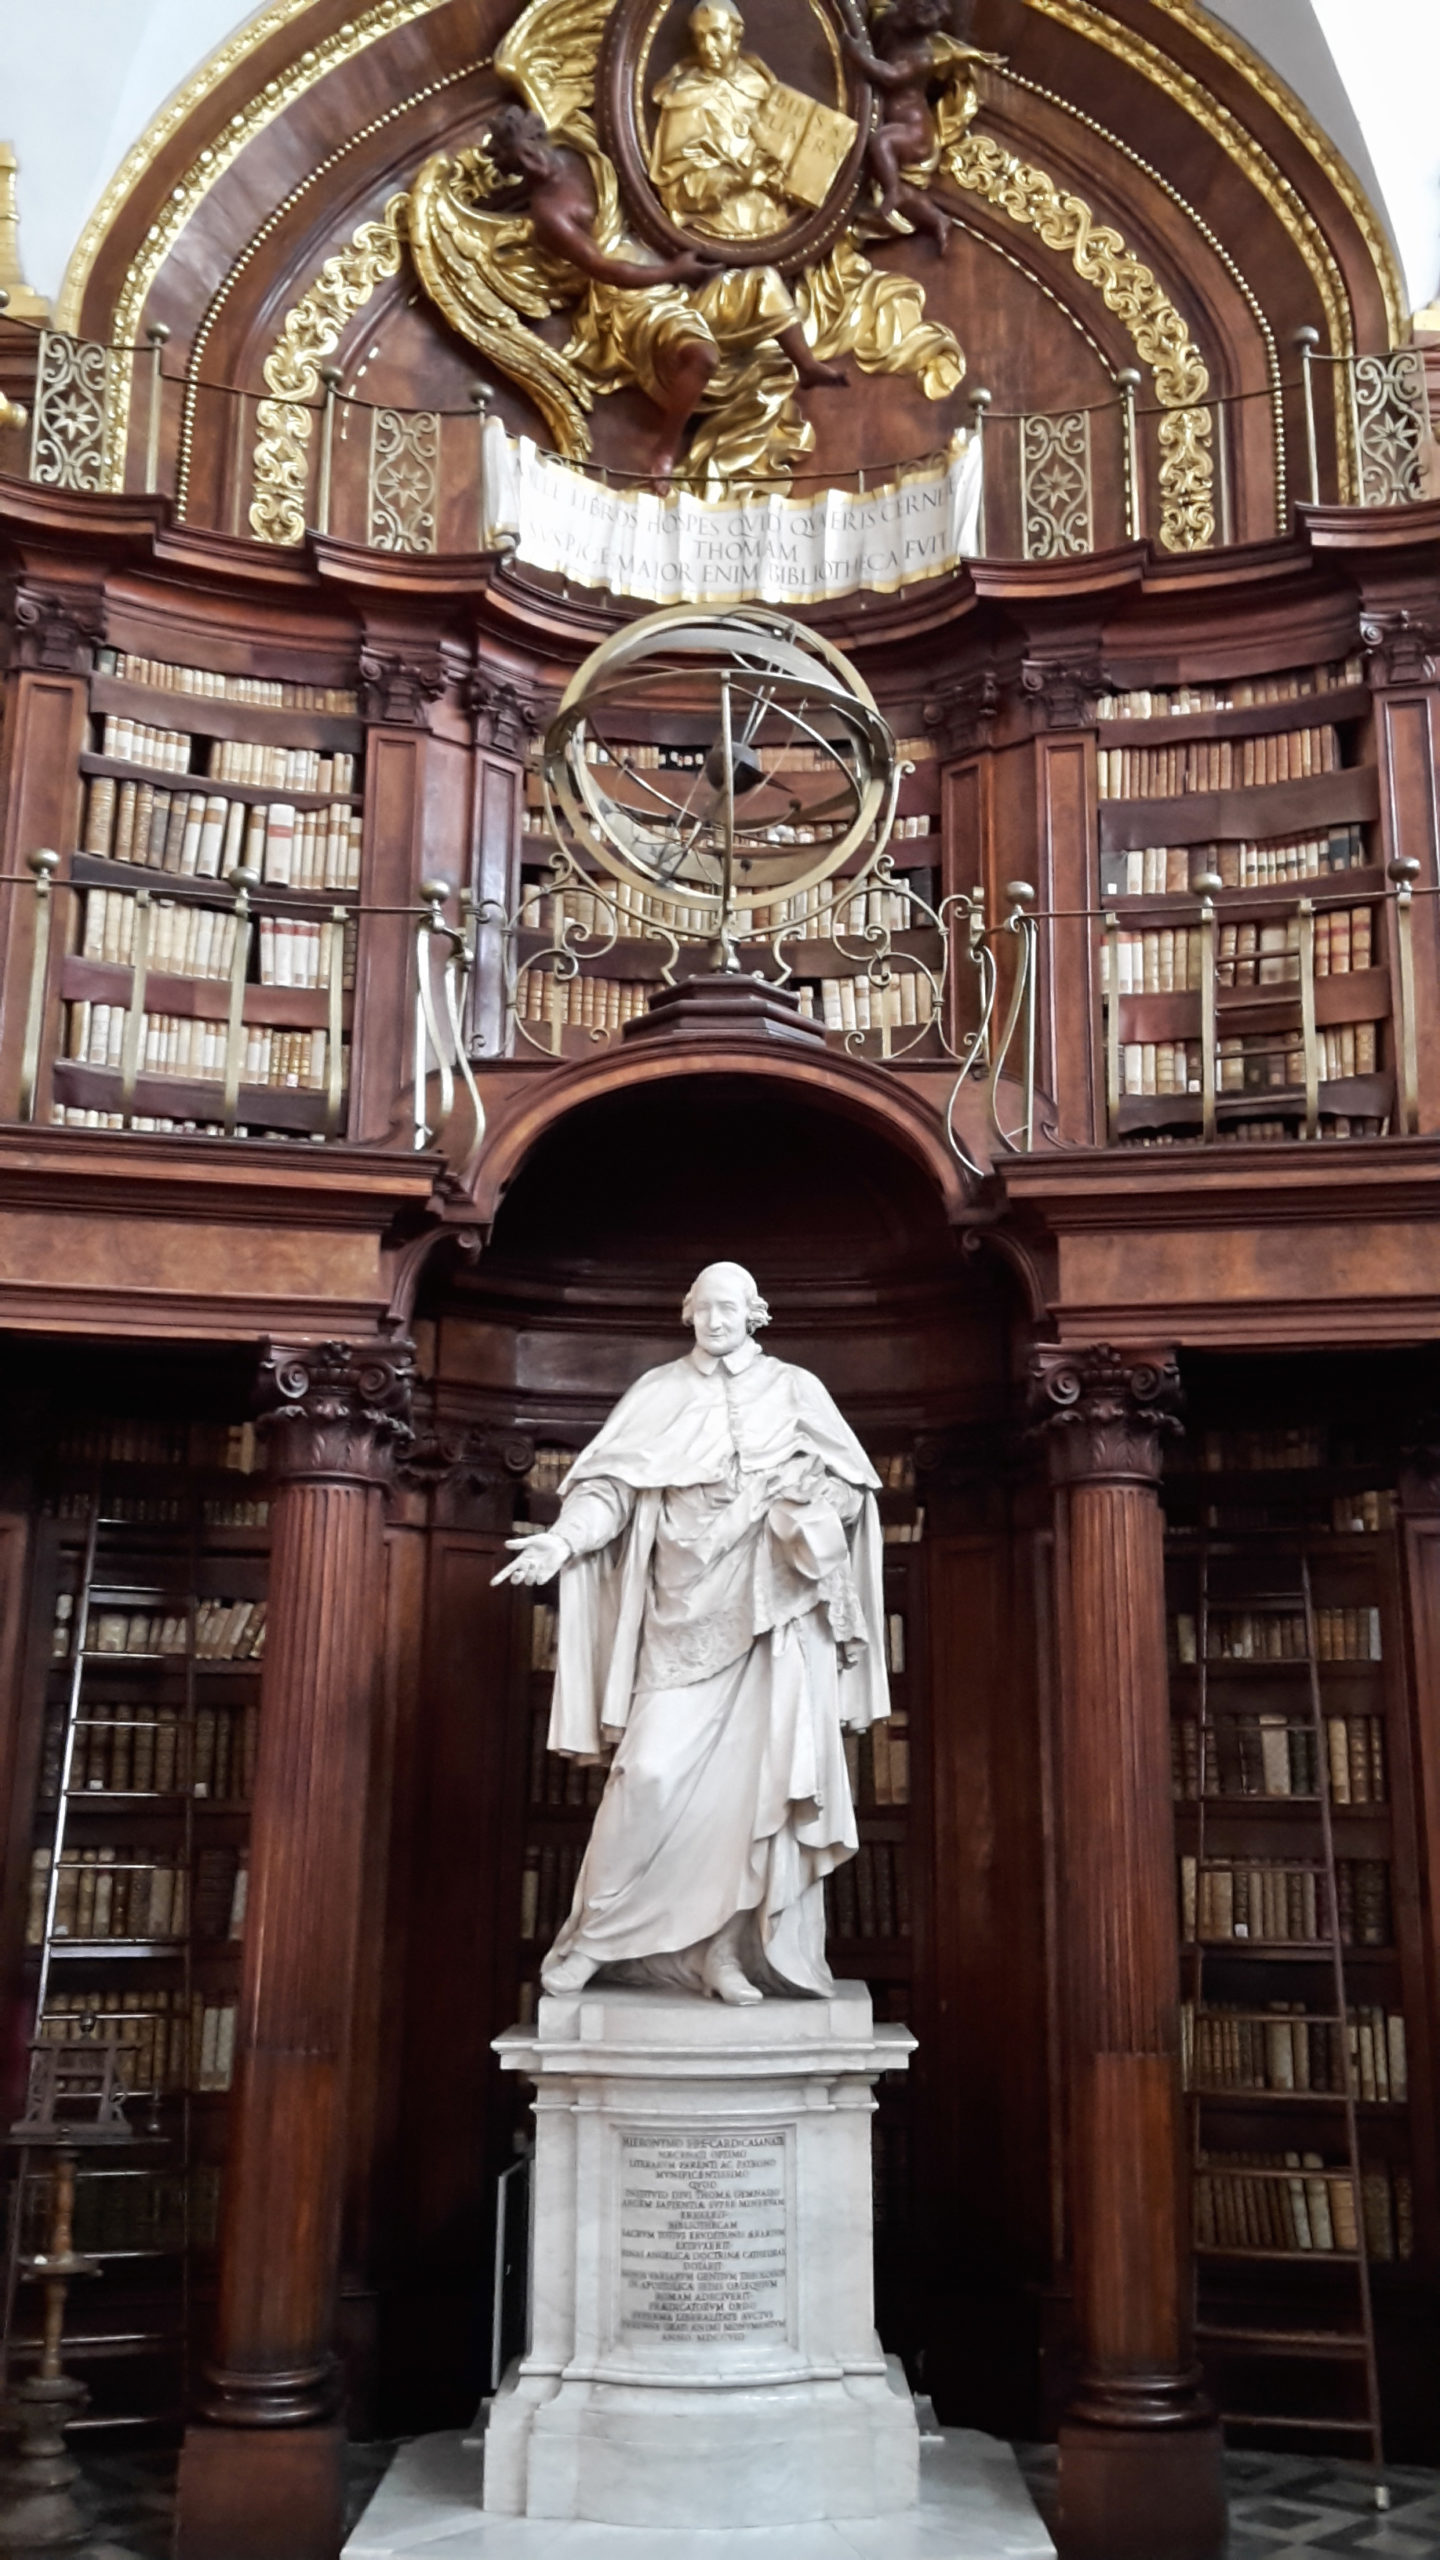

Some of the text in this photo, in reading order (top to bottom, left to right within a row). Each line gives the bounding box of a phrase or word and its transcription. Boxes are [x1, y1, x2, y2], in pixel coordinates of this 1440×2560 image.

[571, 487, 640, 529] LIBROS
[648, 512, 720, 538] HOSPES
[728, 514, 782, 538] QVID
[528, 521, 610, 566] SVSPICE
[617, 554, 693, 584] MAIOR
[703, 562, 759, 584] ENIM
[905, 532, 946, 560] FVIT
[695, 539, 798, 563] THOMAM
